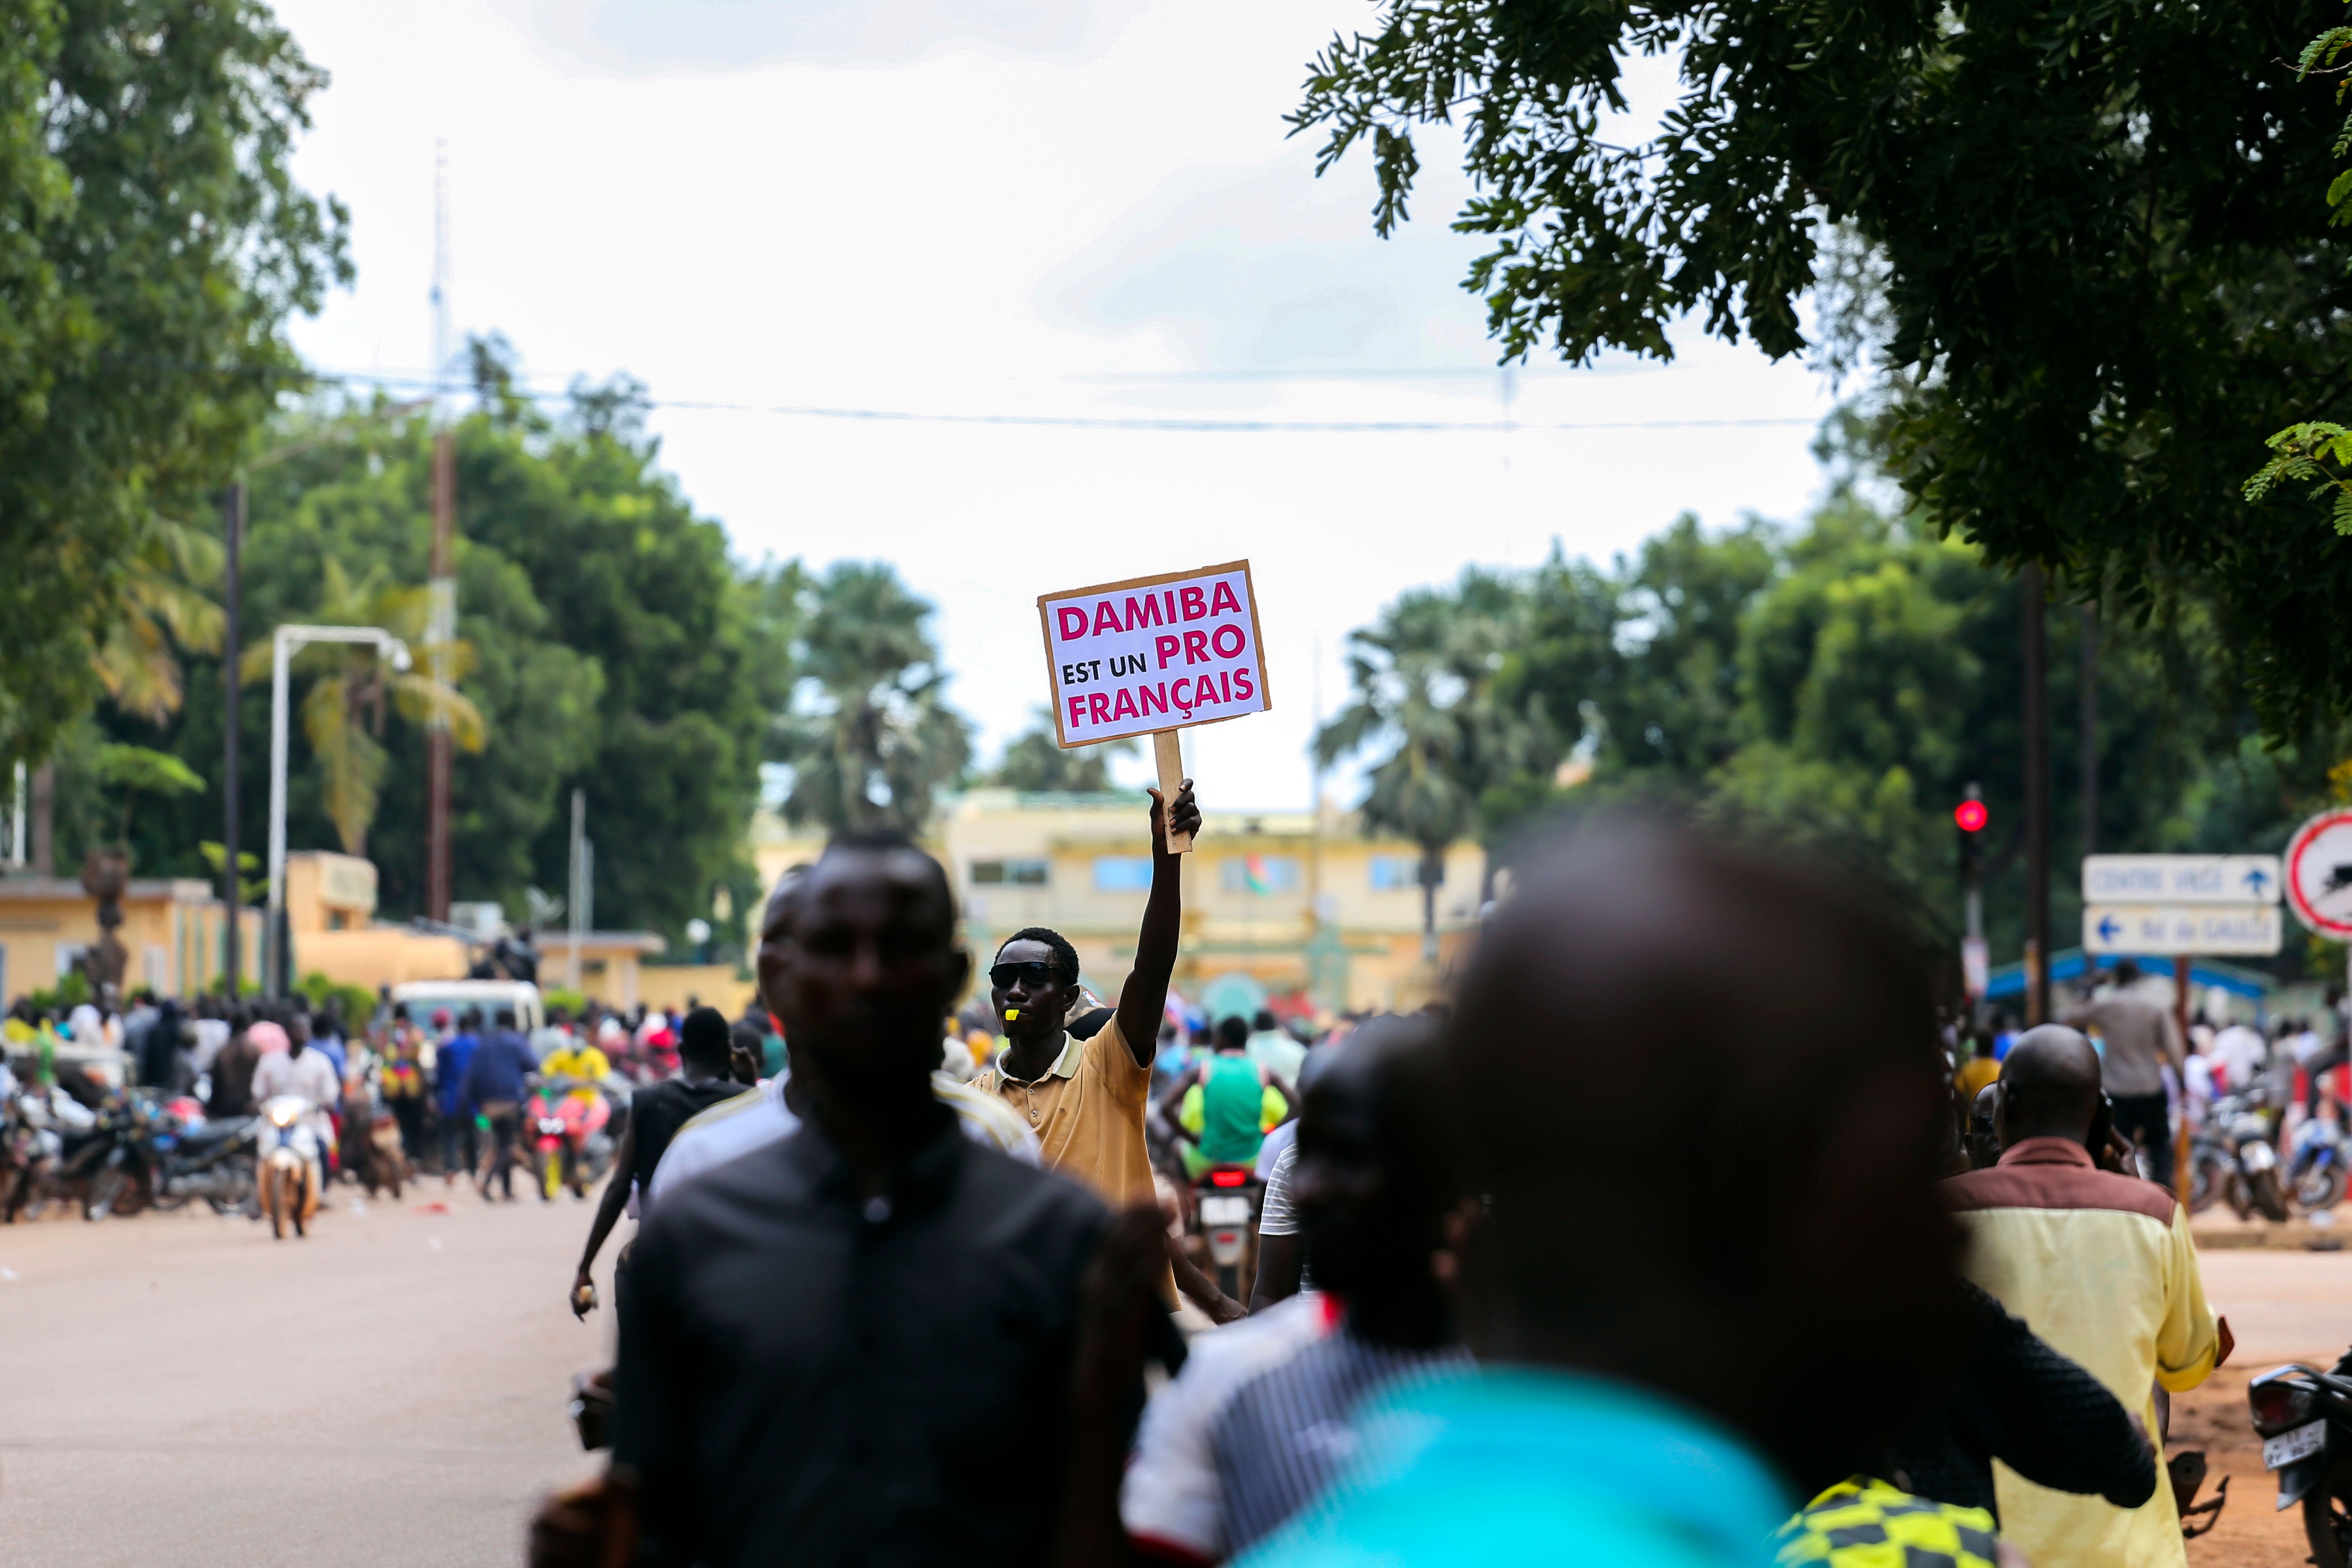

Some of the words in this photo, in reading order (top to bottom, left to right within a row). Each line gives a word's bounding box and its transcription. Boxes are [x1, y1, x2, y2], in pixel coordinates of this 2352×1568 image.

[1057, 581, 1242, 641] DAMIBA
[1062, 660, 1101, 685] EST
[1109, 653, 1147, 677] UN
[1155, 624, 1246, 670] PRO
[1068, 668, 1254, 729] FRANÇAIS
